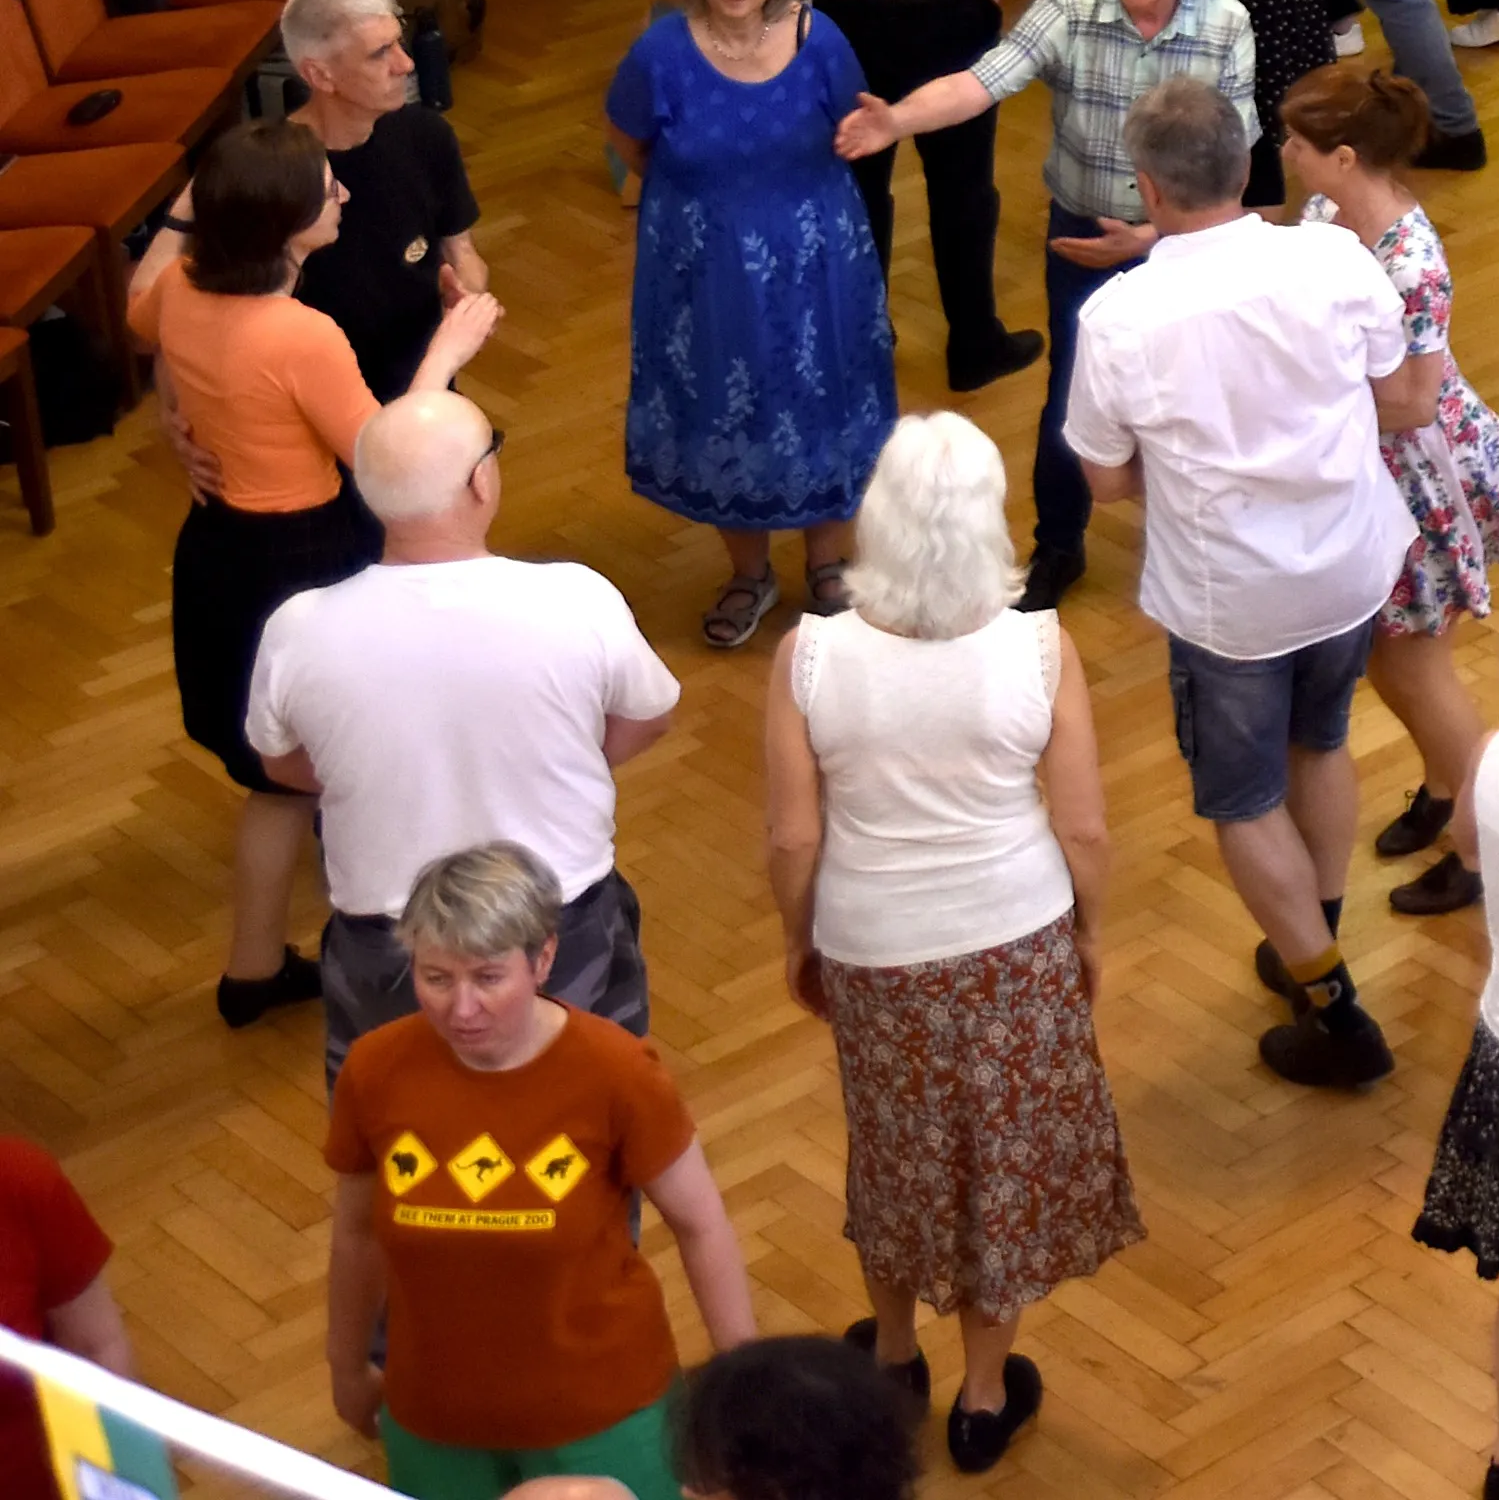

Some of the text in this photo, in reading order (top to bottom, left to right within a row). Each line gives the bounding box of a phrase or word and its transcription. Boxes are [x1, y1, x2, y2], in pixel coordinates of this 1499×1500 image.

[459, 1213, 472, 1223] AT
[476, 1214, 518, 1224] PRAGUE
[525, 1215, 548, 1224] ZOO
